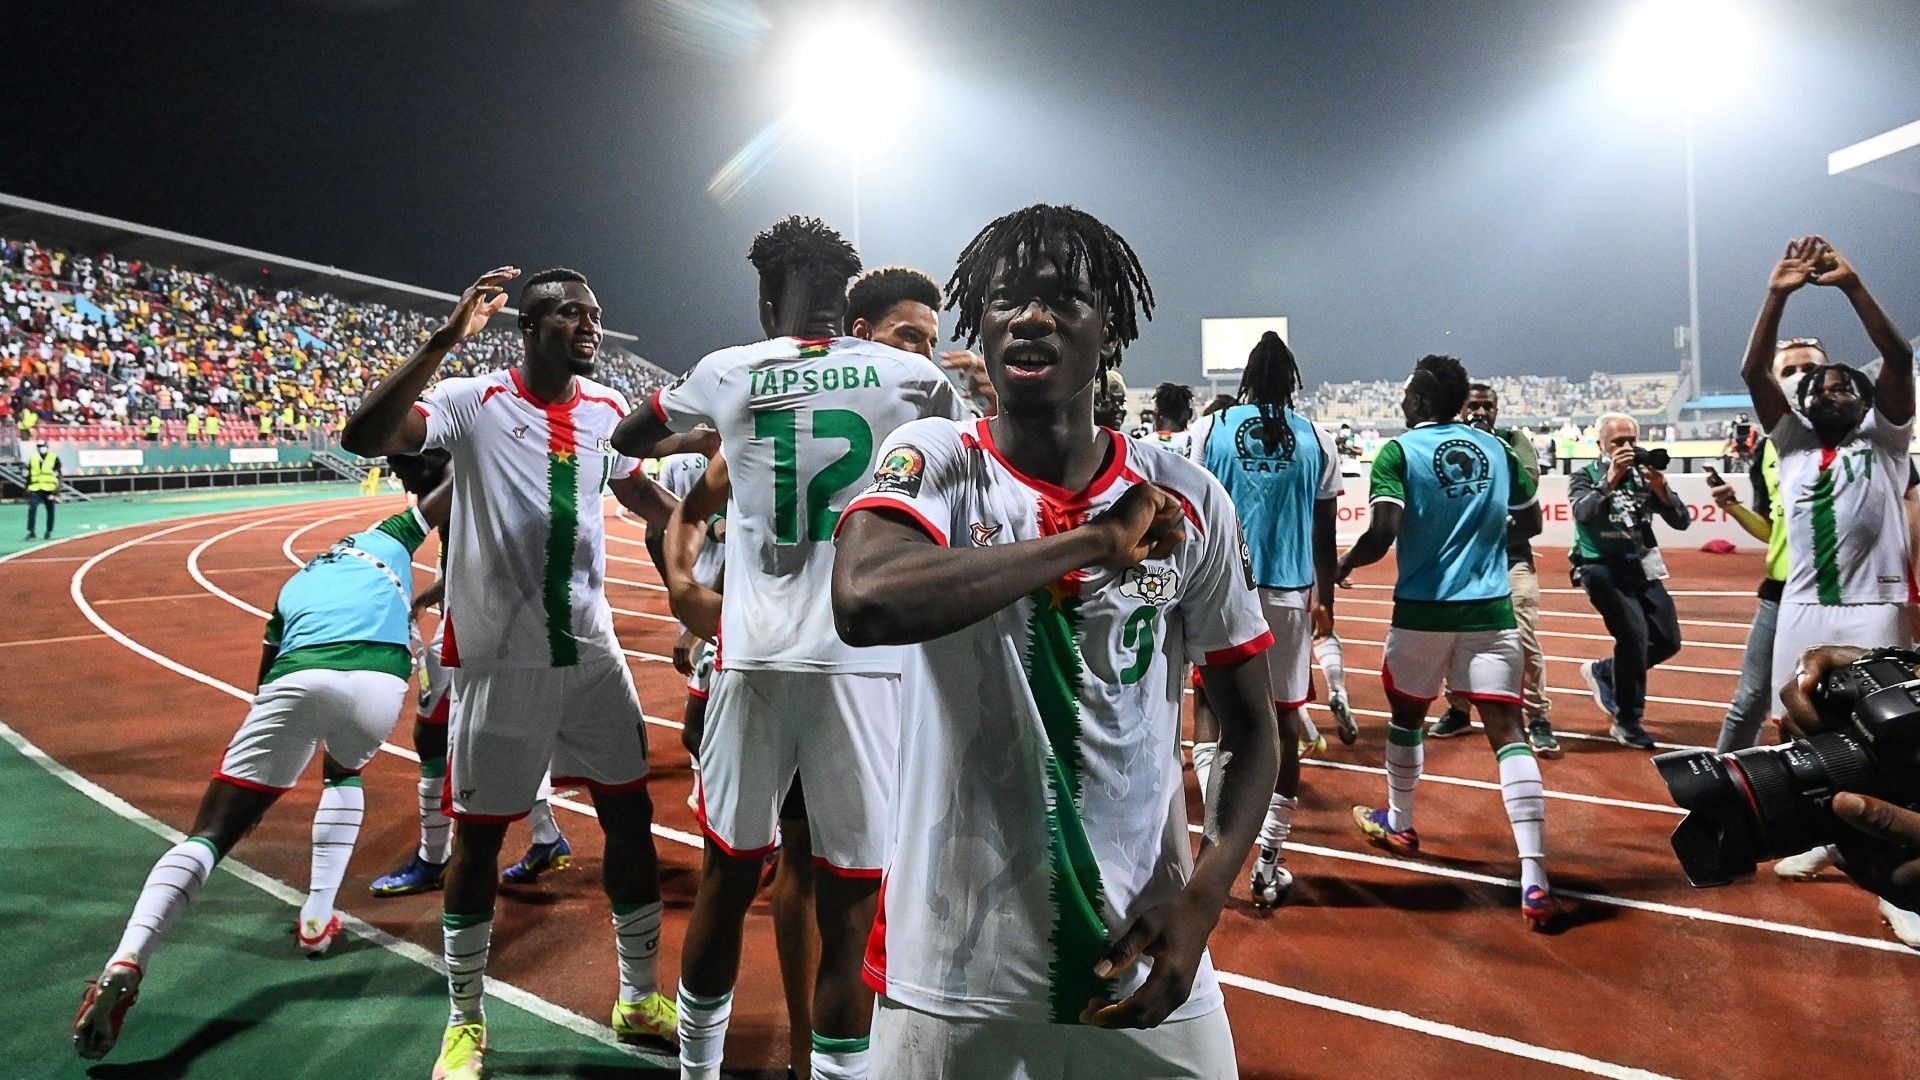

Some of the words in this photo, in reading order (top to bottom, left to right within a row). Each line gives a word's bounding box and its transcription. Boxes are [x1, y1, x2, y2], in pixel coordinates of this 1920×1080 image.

[749, 366, 881, 395] TAPSOBA
[695, 456, 710, 469] SI
[1242, 461, 1288, 473] CAF
[1843, 449, 1872, 483] 17
[754, 409, 873, 545] 12
[1446, 483, 1488, 498] CAF
[1338, 507, 1366, 521] OF
